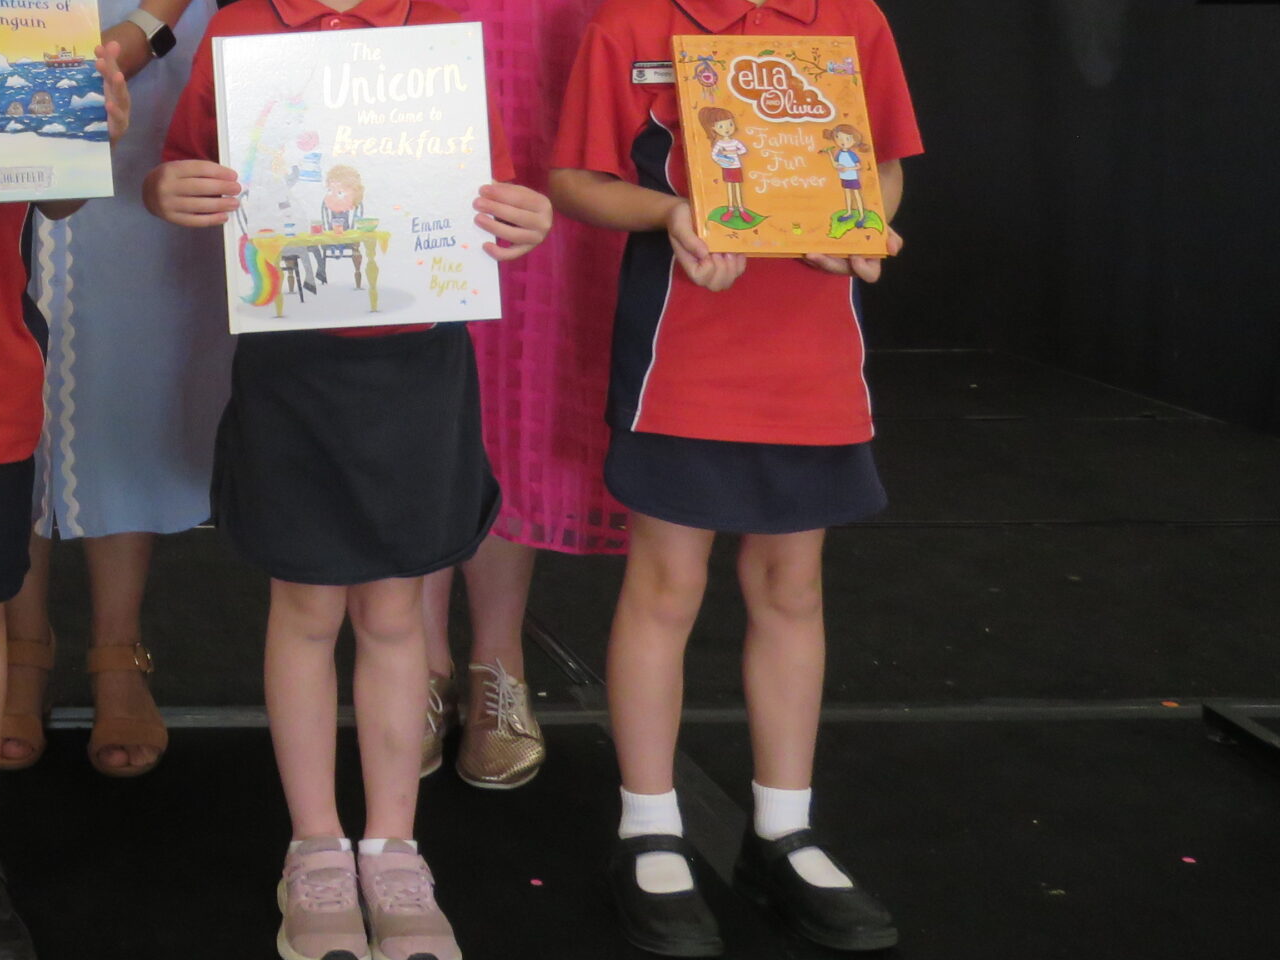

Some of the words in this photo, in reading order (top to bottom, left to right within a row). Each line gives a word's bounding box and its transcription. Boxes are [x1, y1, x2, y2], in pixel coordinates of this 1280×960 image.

[56, 0, 71, 11] of
[351, 42, 382, 61] The
[323, 62, 468, 109] Unicorn
[761, 89, 825, 114] Olivia
[357, 109, 385, 124] Who
[390, 108, 423, 123] Came
[430, 106, 442, 121] to
[333, 125, 475, 159] Breakfast
[745, 127, 816, 152] Family
[761, 149, 808, 172] Fun
[748, 171, 827, 194] Forever
[412, 217, 451, 233] Emma
[414, 233, 456, 252] Adams
[431, 257, 463, 272] Mike
[430, 275, 468, 297] Byrne
